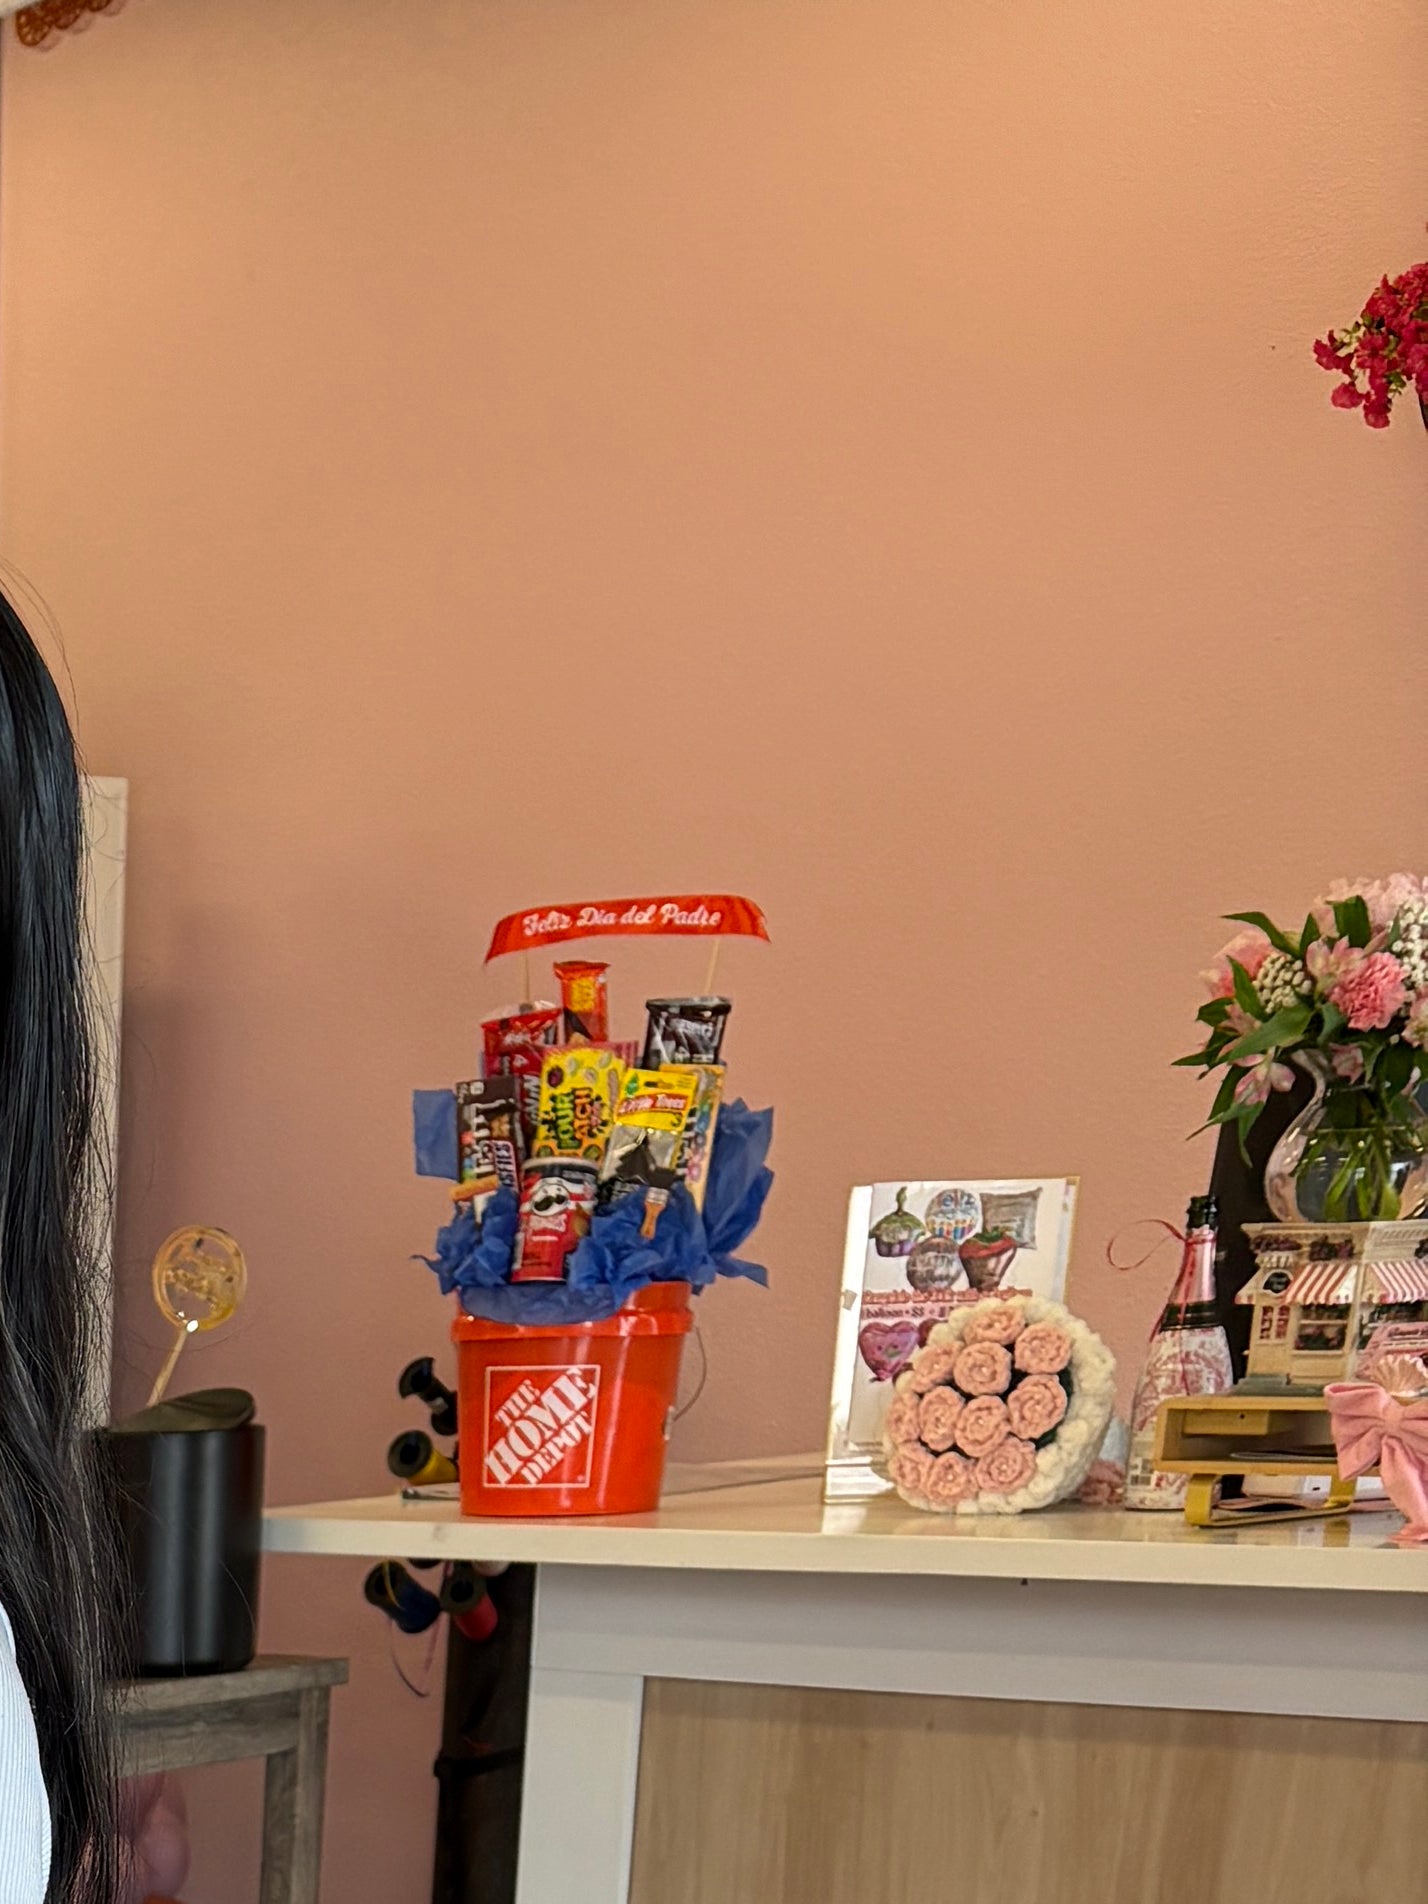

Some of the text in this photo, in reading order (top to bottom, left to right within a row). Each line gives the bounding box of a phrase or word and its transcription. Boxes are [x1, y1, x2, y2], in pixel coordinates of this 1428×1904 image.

[522, 912, 573, 936] Feliz
[620, 904, 657, 926] del
[660, 902, 722, 927] Padre
[485, 1367, 597, 1485] HOME
[495, 1379, 541, 1427] THE
[520, 1411, 593, 1485] DEPOT
